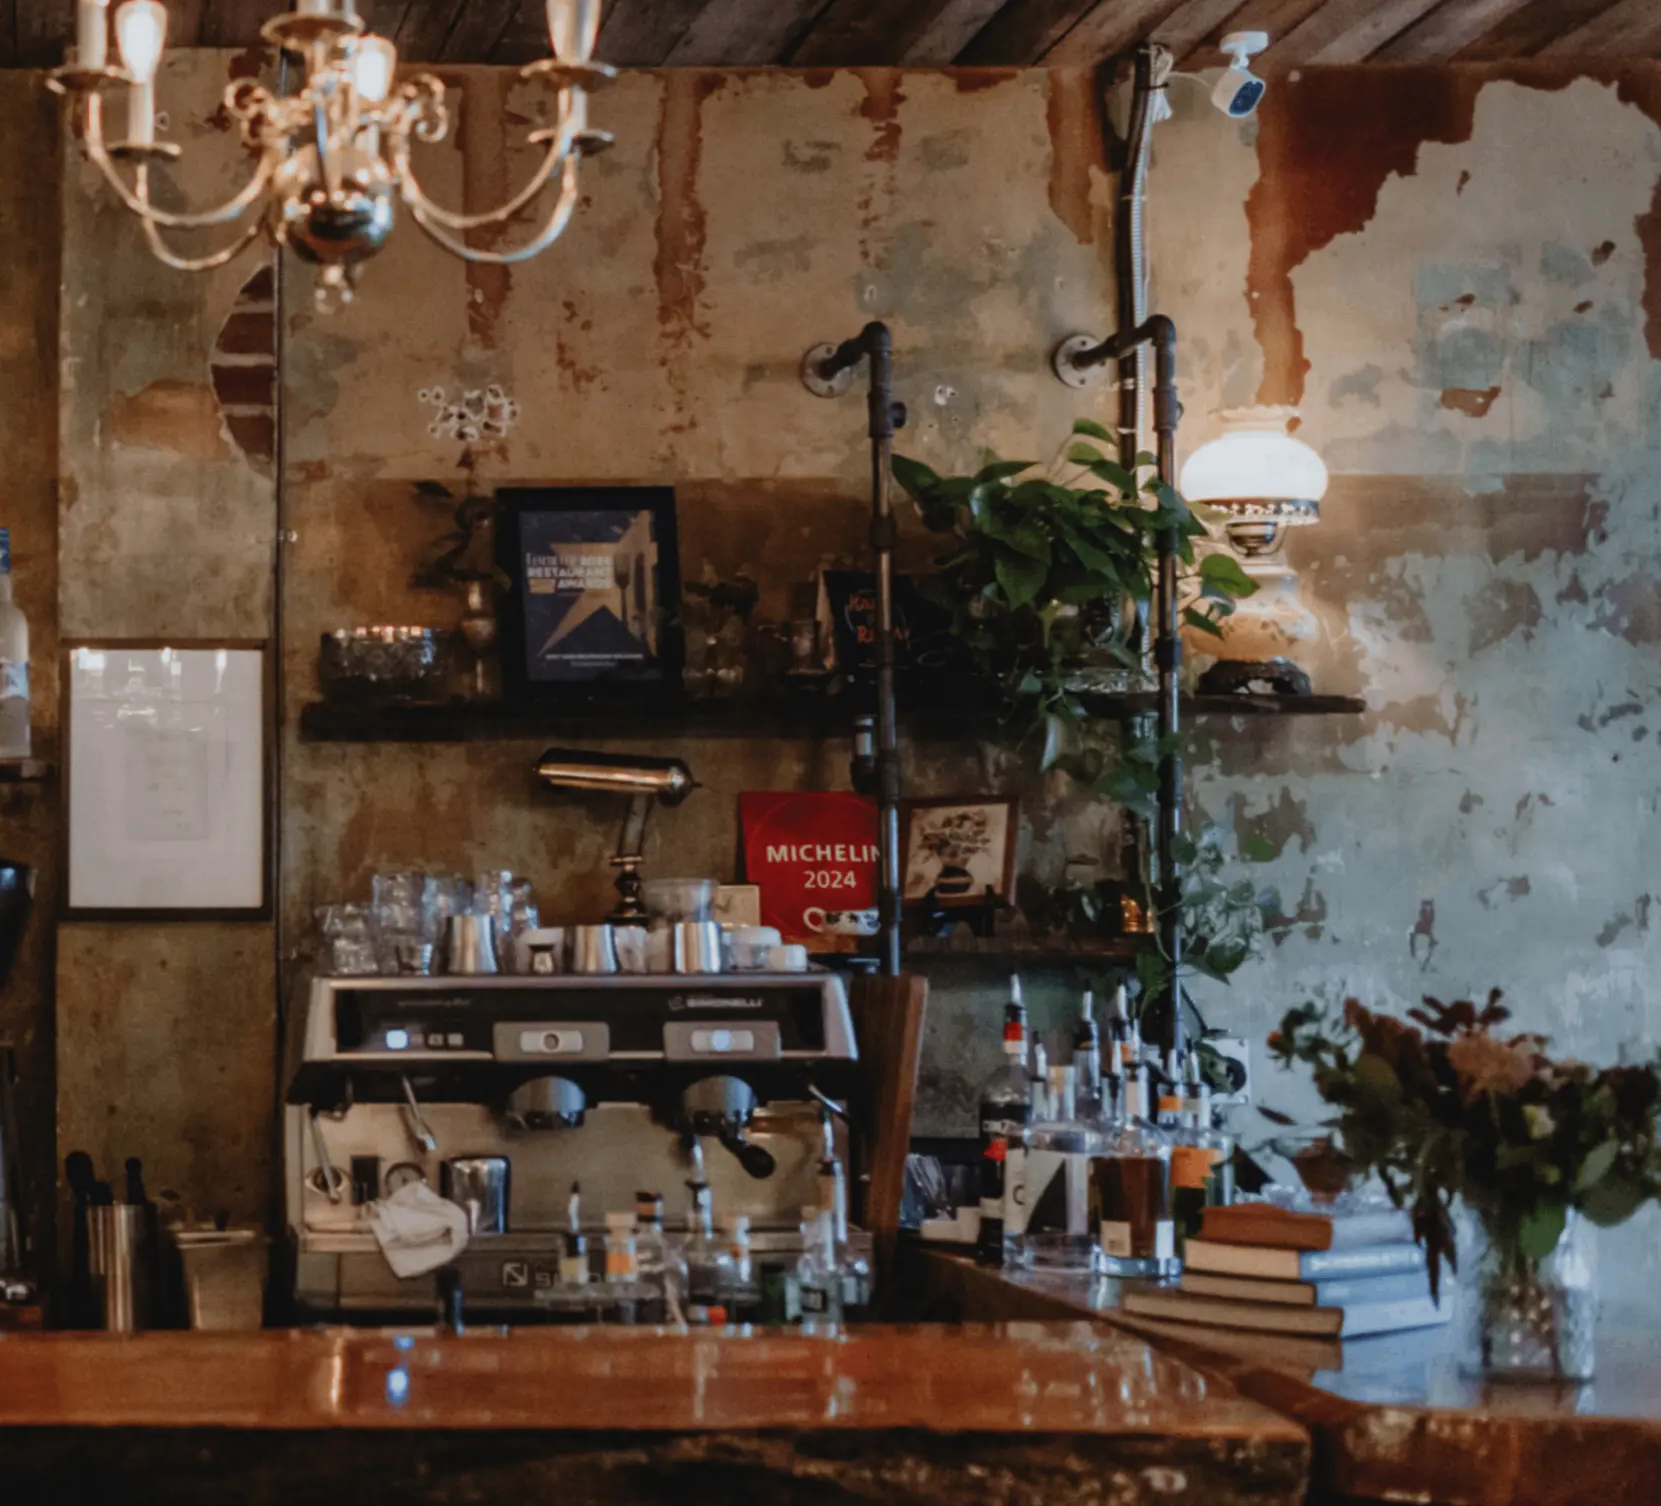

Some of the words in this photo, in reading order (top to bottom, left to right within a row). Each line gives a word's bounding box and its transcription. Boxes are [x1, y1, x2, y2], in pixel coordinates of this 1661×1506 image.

[526, 566, 615, 579] RESTAURANT
[765, 843, 881, 863] MICHELIN
[803, 869, 857, 889] 2024
